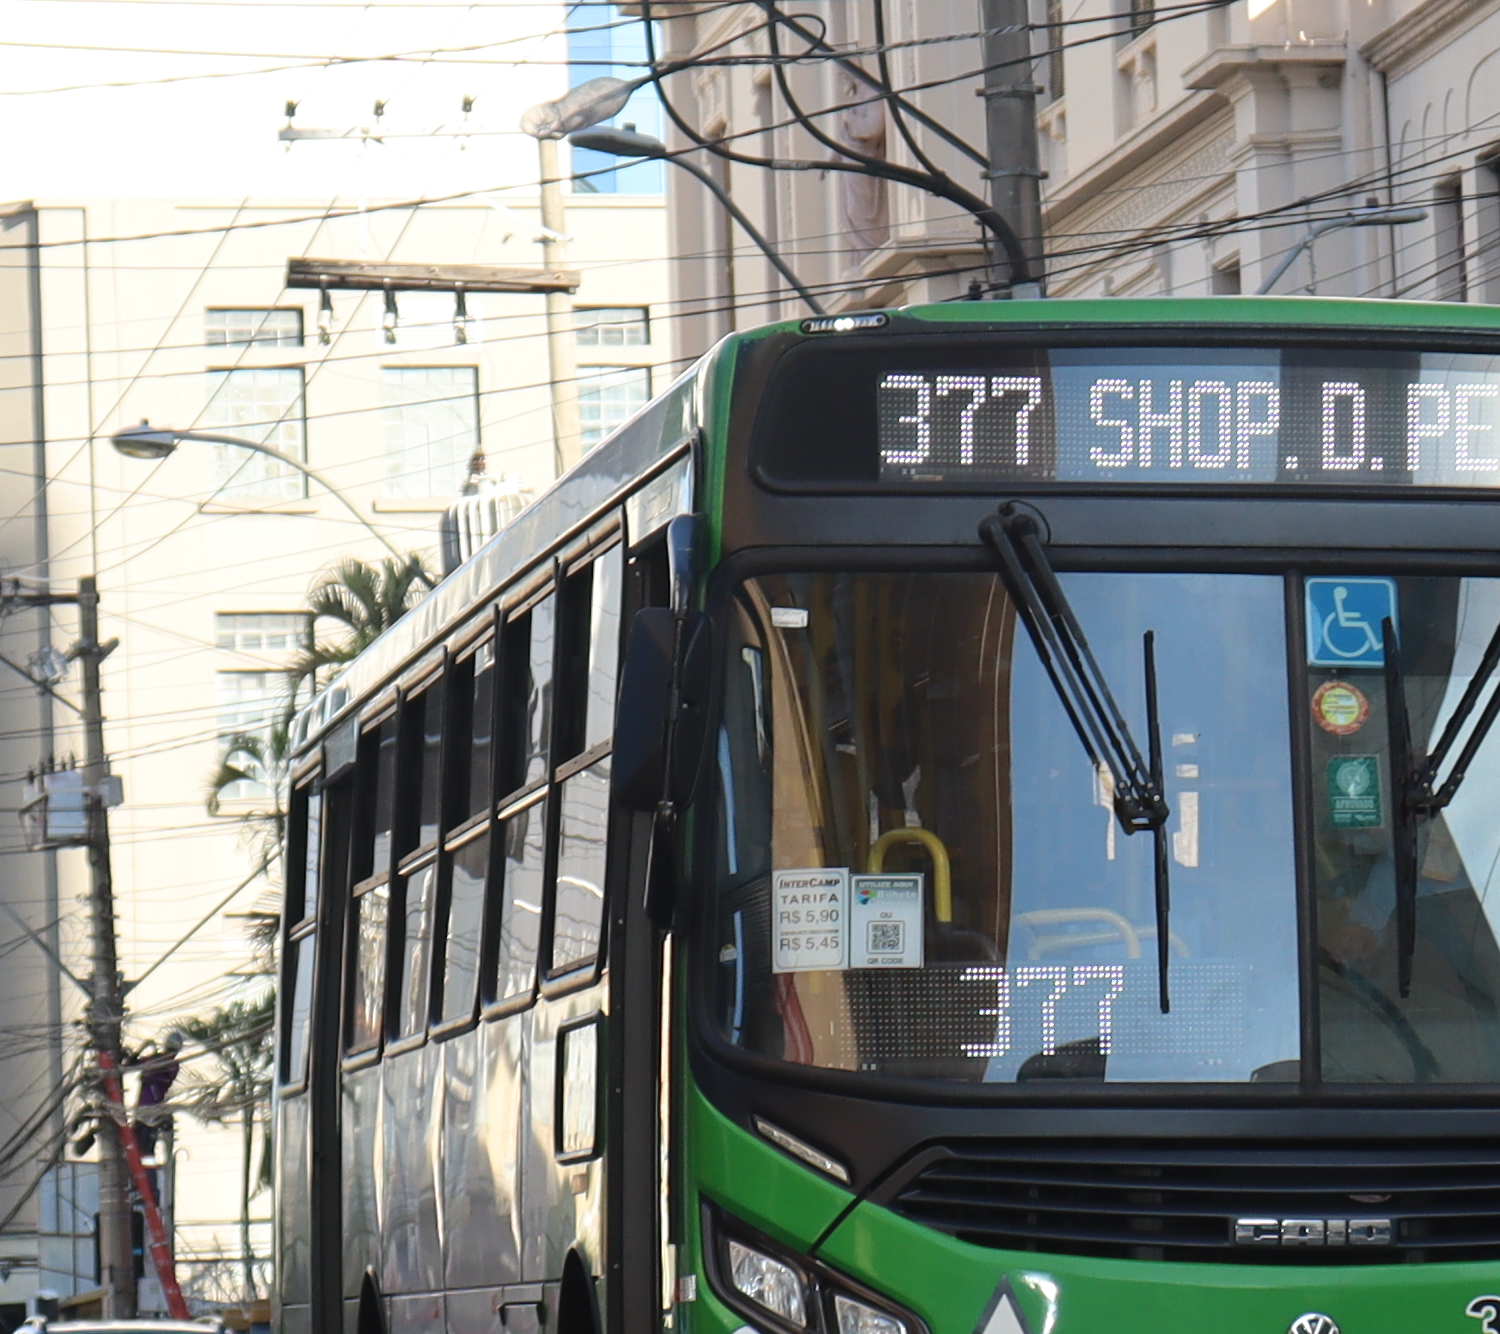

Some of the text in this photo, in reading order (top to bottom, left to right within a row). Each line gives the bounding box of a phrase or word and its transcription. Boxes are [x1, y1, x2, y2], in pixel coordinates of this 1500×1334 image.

[880, 375, 1043, 465] 377
[780, 893, 838, 905] TARIFA
[779, 909, 839, 924] R$ 5,90
[779, 935, 839, 951] R$ 5,45
[881, 957, 903, 965] CODE
[959, 965, 1124, 1057] 377
[1235, 1219, 1392, 1245] CAIO
